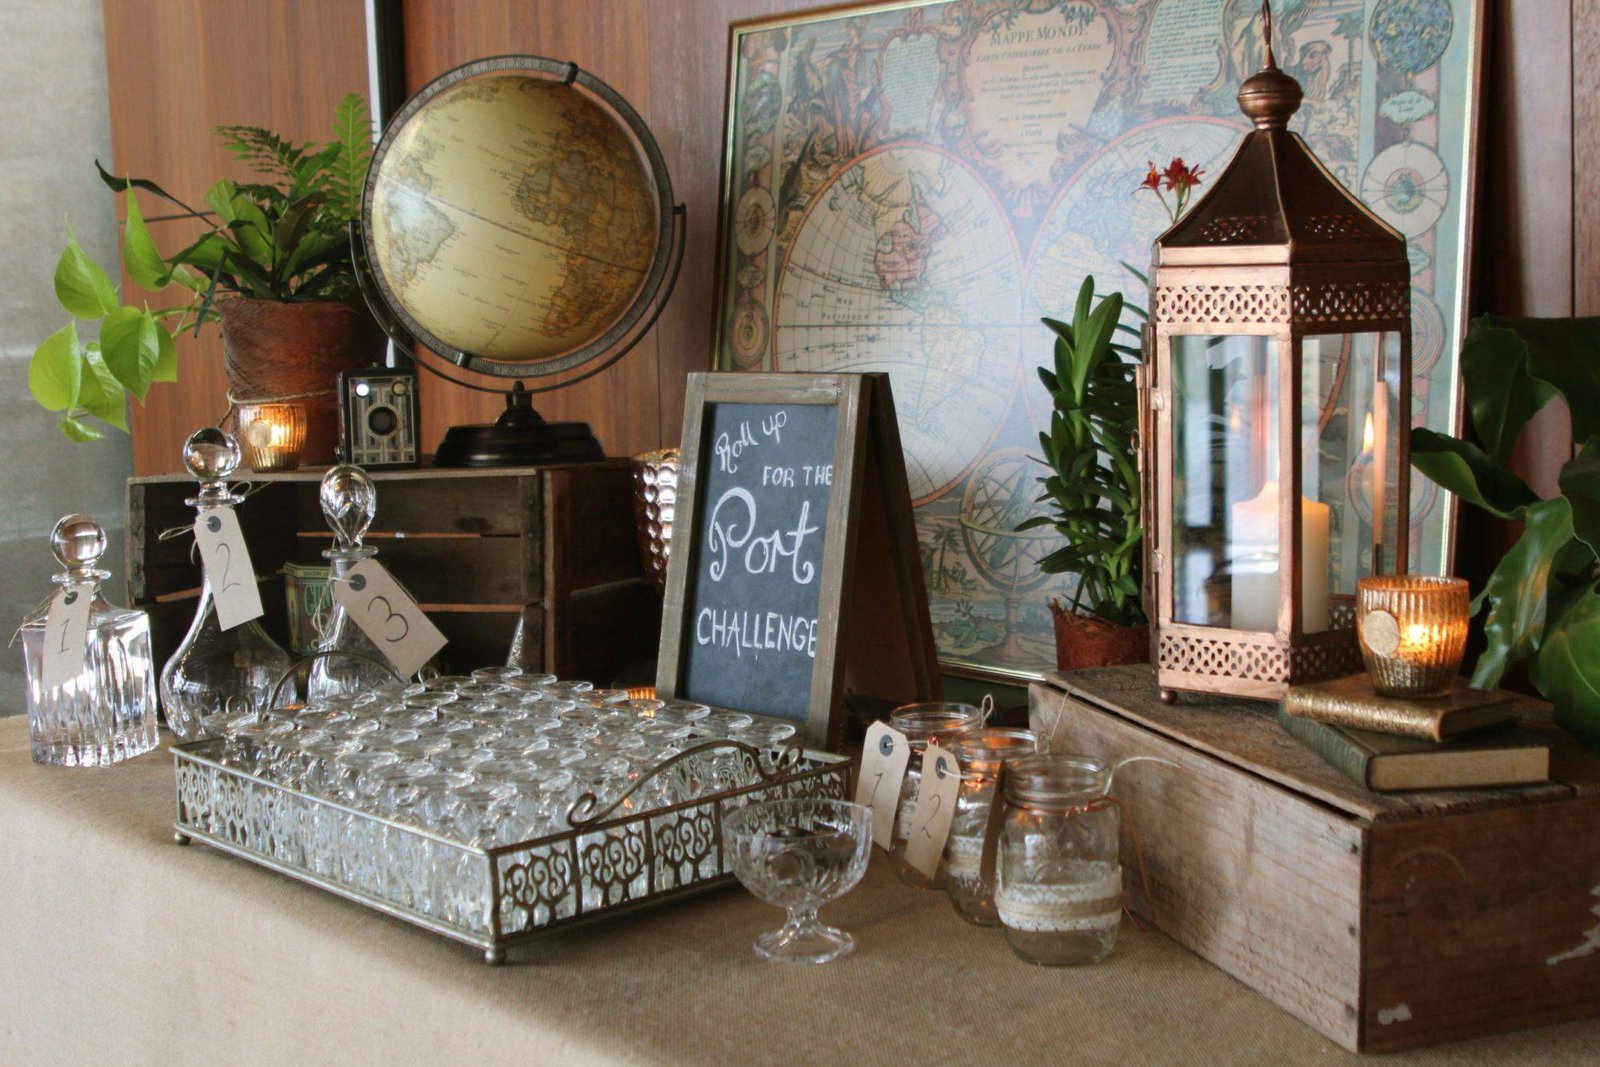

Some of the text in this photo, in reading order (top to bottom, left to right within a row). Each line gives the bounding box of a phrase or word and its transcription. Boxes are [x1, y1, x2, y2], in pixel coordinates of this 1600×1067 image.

[991, 24, 1089, 46] MAPPE MONDE
[715, 421, 760, 474] Roll
[762, 464, 833, 488] FOR THE
[708, 486, 820, 585] Port
[215, 541, 241, 594] 2
[57, 616, 72, 654] 1
[366, 594, 410, 645] 3
[696, 607, 819, 658] CHALLENGE
[866, 771, 884, 809] 1
[919, 793, 942, 840] 2
